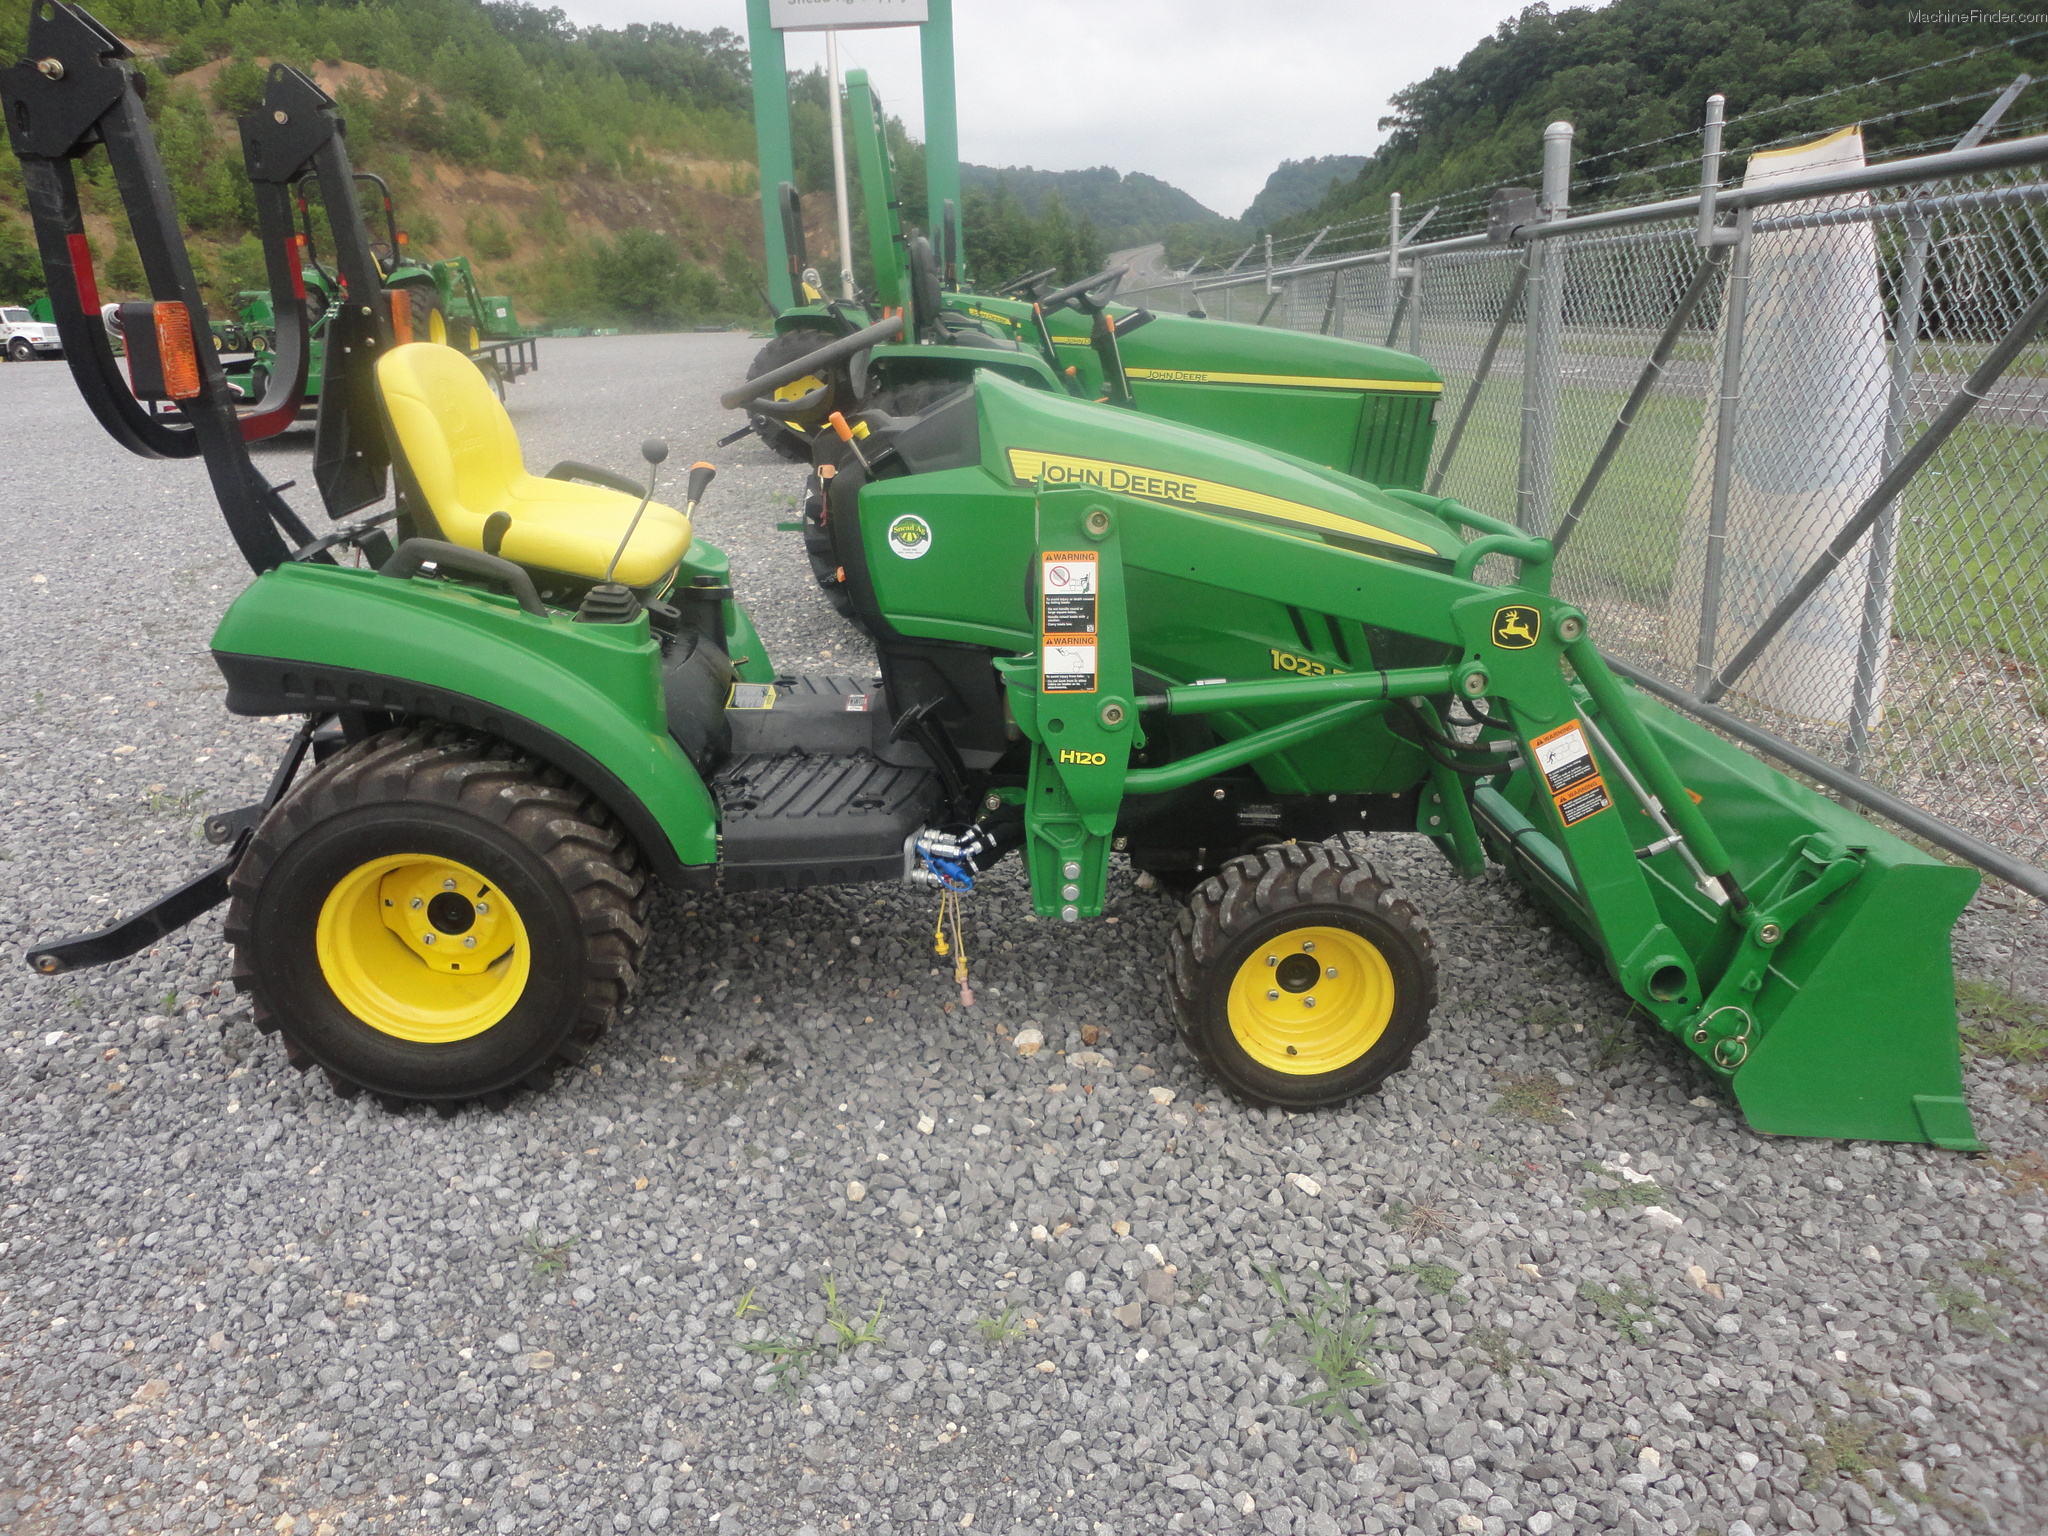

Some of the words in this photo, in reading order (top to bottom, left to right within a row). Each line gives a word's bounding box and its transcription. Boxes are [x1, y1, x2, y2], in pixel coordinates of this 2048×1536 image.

[1147, 370, 1174, 379] JOHN
[1175, 371, 1208, 381] DEERE
[1032, 461, 1103, 487] JOHN
[1110, 468, 1197, 501] DEERE
[1053, 553, 1095, 561] WARNING
[1053, 637, 1094, 645] WARNING
[1543, 724, 1574, 742] WARNING
[1060, 749, 1106, 766] H120
[1567, 781, 1598, 798] WARNING
